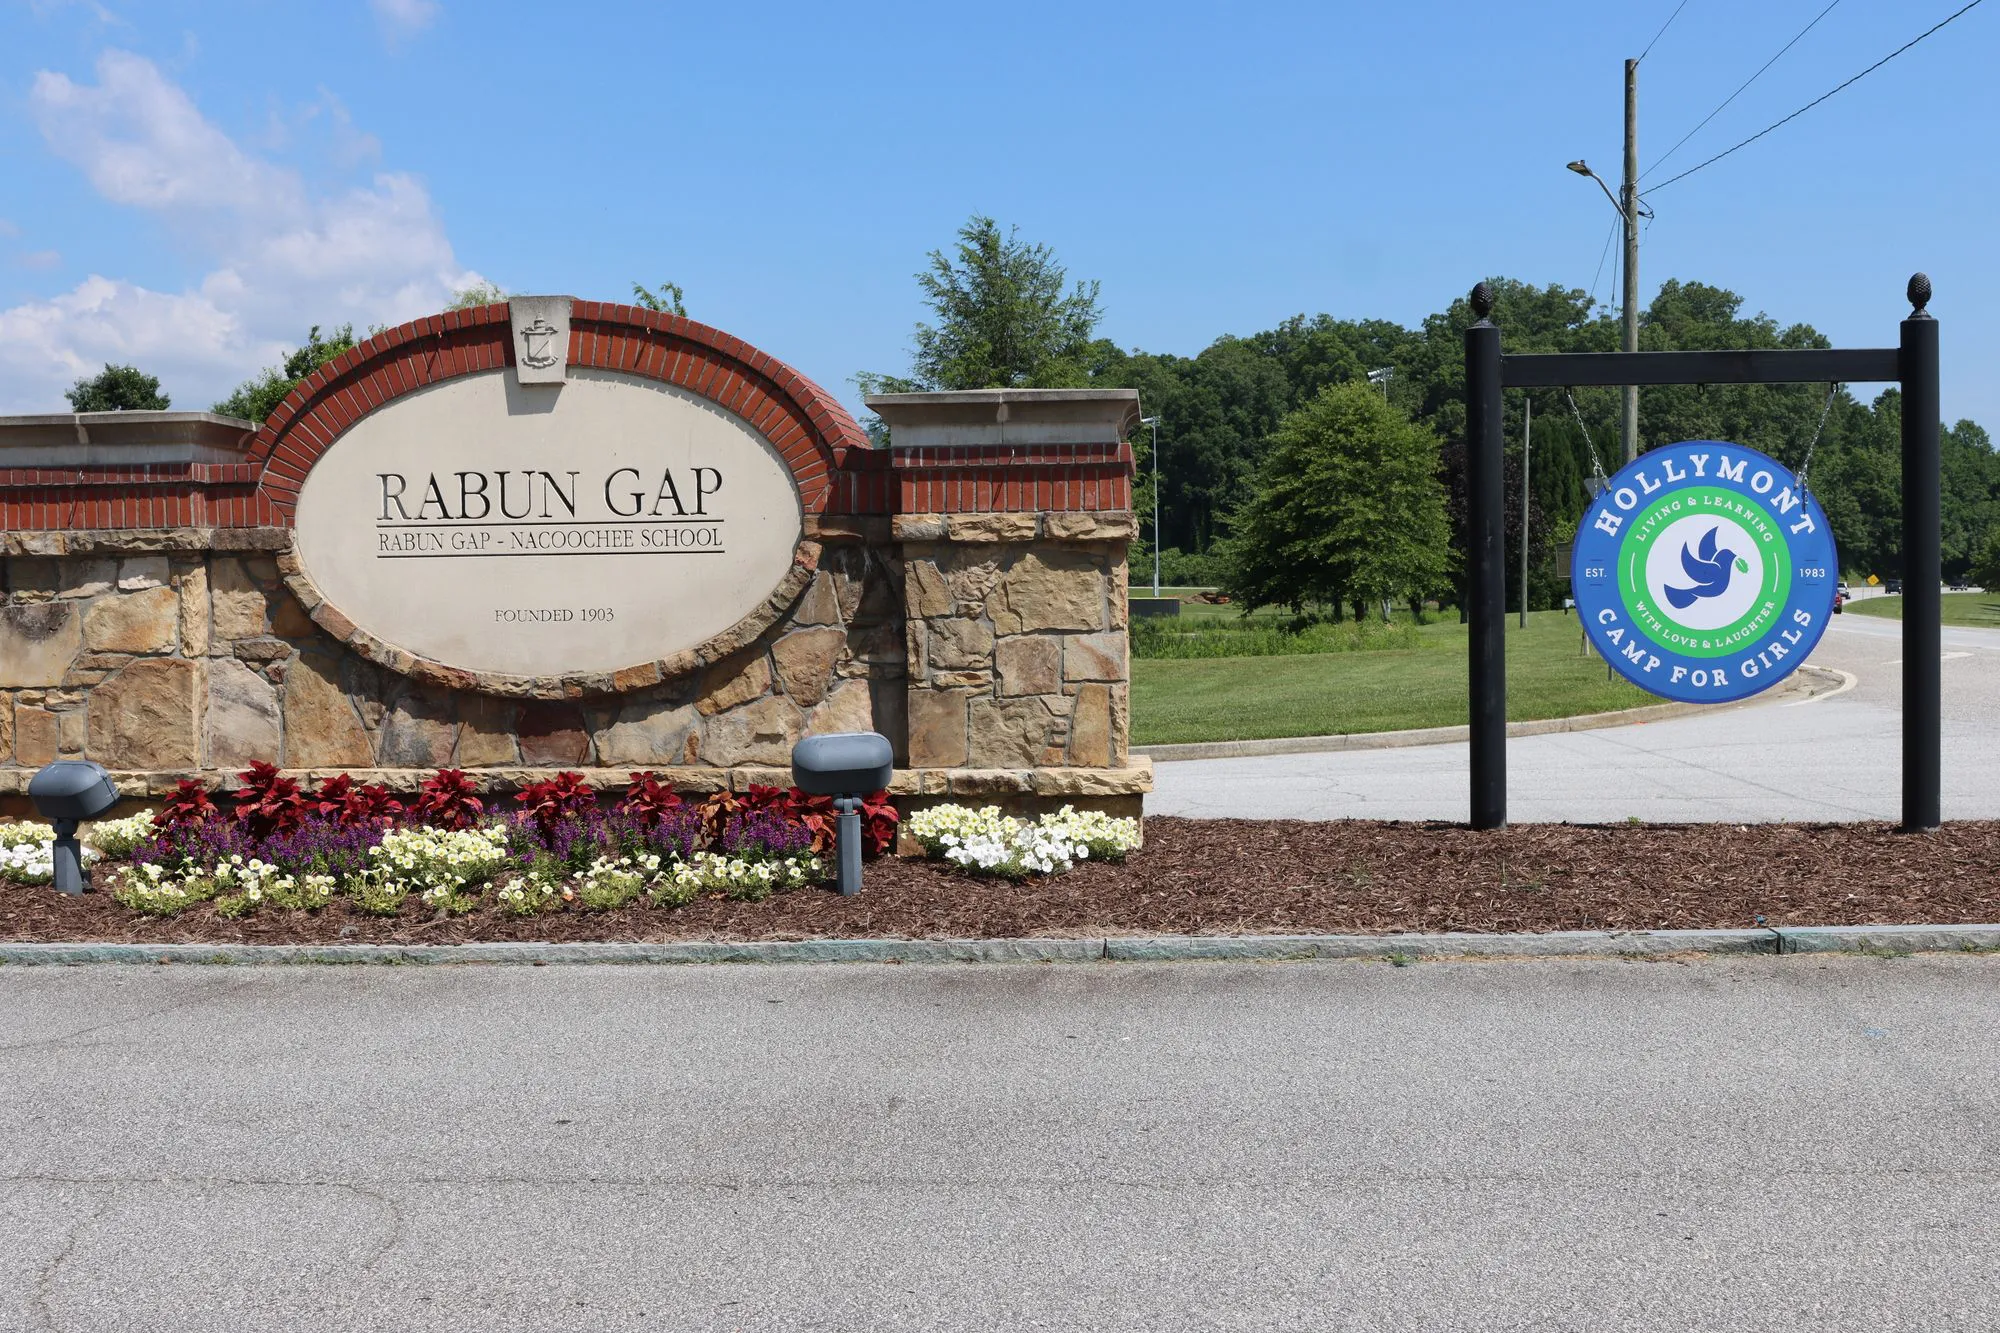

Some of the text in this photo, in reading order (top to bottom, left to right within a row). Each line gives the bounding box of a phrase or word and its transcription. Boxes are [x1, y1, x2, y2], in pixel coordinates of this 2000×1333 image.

[376, 467, 723, 521] RABUN GAP
[1594, 454, 1816, 537] HOLLYMONT
[377, 531, 444, 552] RABUN
[451, 530, 491, 551] GAP
[510, 529, 635, 550] NACOOCHEE
[641, 528, 723, 548] SCHOOL
[1635, 495, 1773, 543] LIVING & LEARNING
[1585, 568, 1608, 578] EST.
[1799, 568, 1825, 578] 1983
[494, 607, 615, 623] FOUNDED 1903
[1636, 600, 1775, 649] WITH LOVE & LAUGHTER
[1598, 608, 1812, 687] CAMP FOR GIRLS
